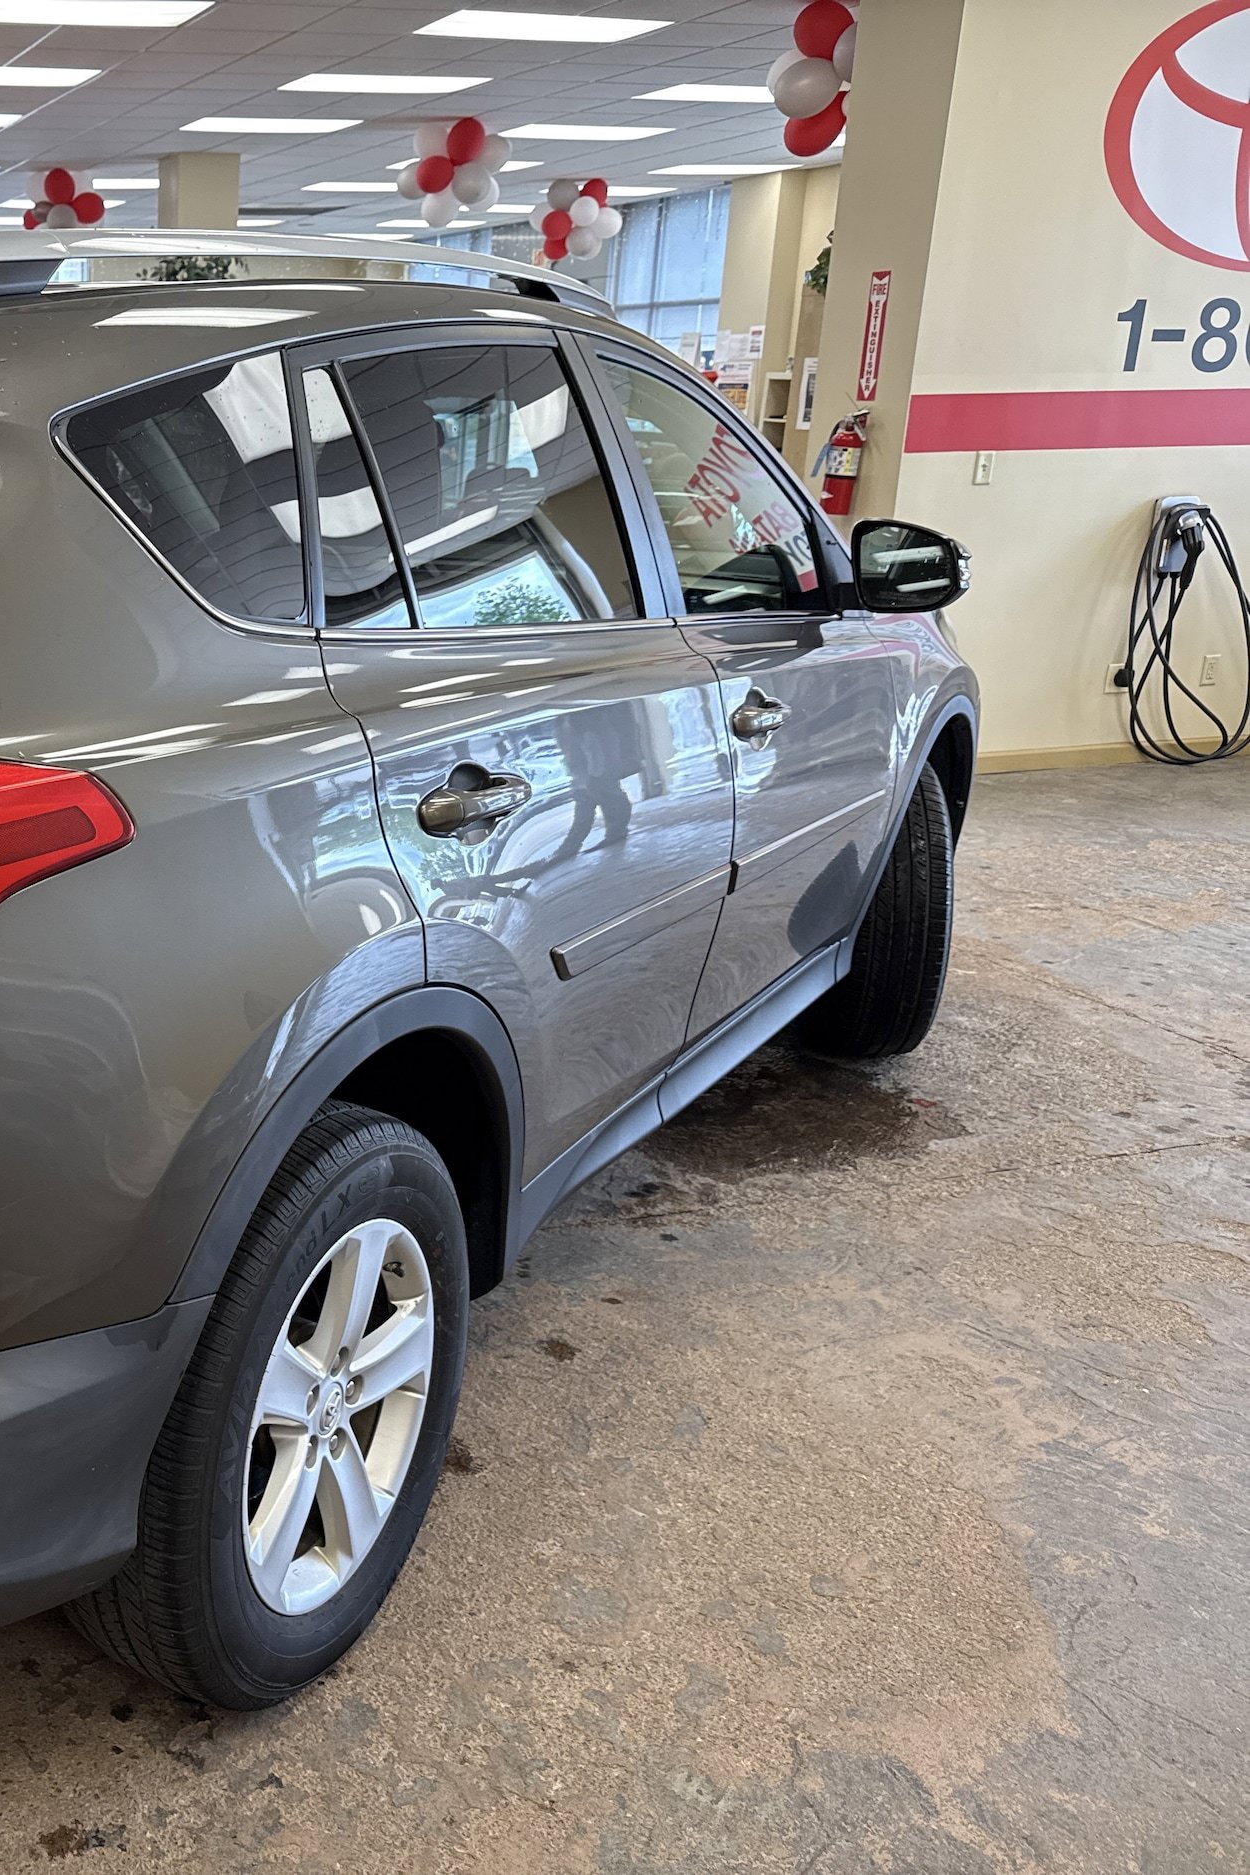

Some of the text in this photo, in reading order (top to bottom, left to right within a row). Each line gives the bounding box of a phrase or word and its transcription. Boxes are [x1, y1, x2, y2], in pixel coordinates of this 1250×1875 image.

[872, 283, 887, 296] FIRE
[864, 300, 881, 391] EXTINGUISHER
[1116, 297, 1250, 373] 1-8
